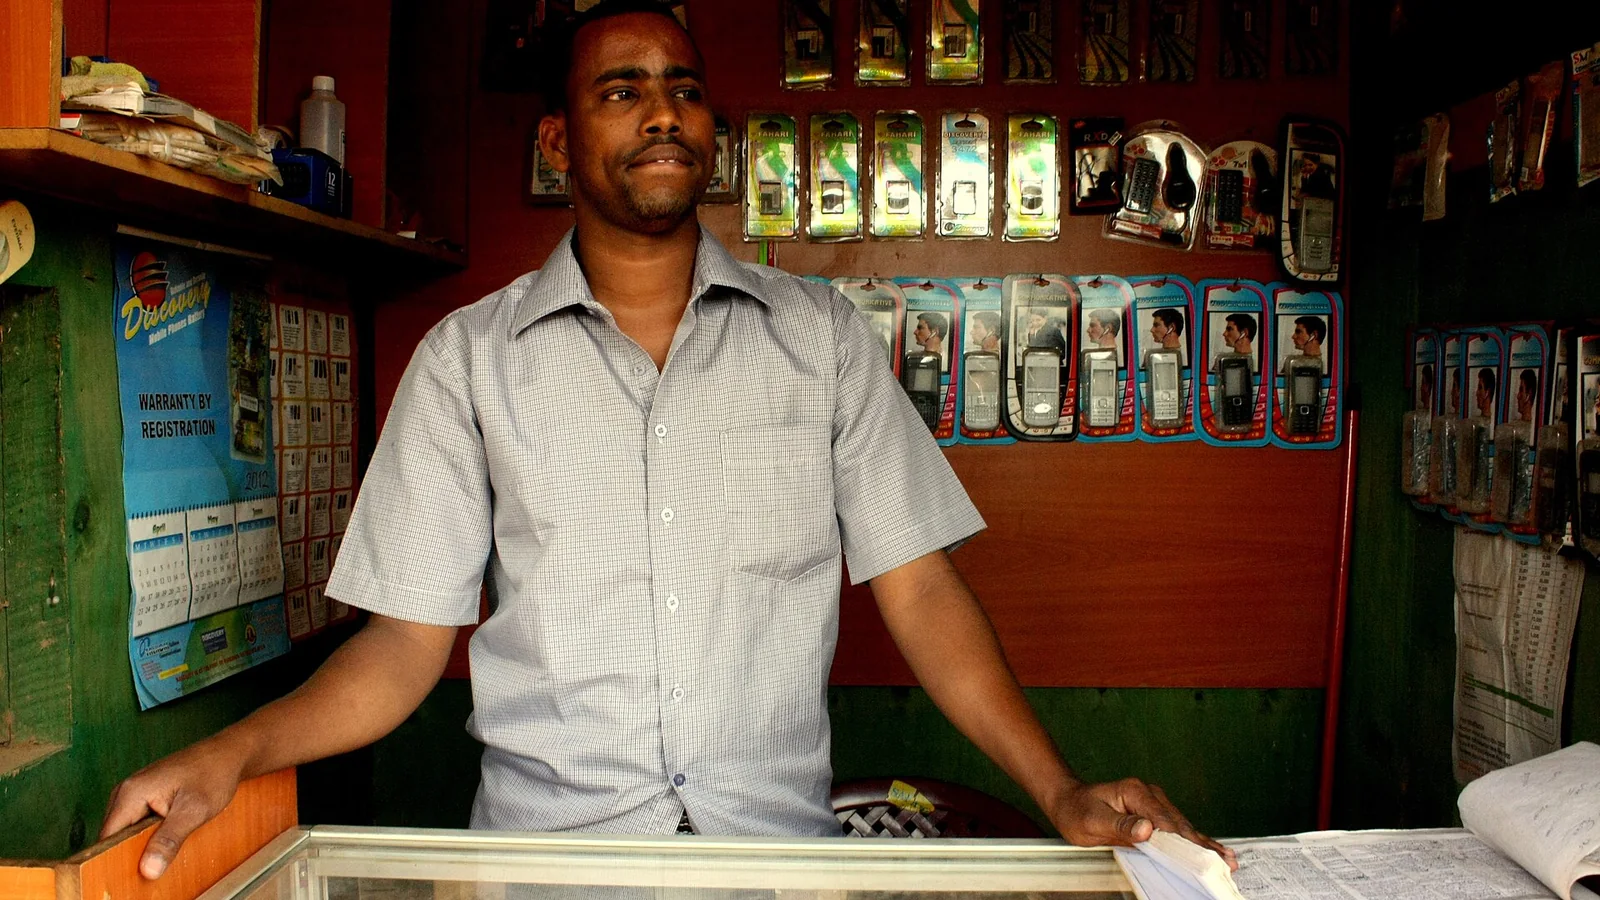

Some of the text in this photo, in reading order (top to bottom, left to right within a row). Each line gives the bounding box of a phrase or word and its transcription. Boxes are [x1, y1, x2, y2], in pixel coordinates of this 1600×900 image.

[1083, 132, 1109, 143] RXD
[327, 171, 336, 187] 12
[121, 280, 212, 341] Discovery
[139, 393, 212, 411] WARRANTY BY
[141, 419, 216, 439] REGISTRATION
[245, 470, 270, 491] 2012
[153, 523, 166, 534] April
